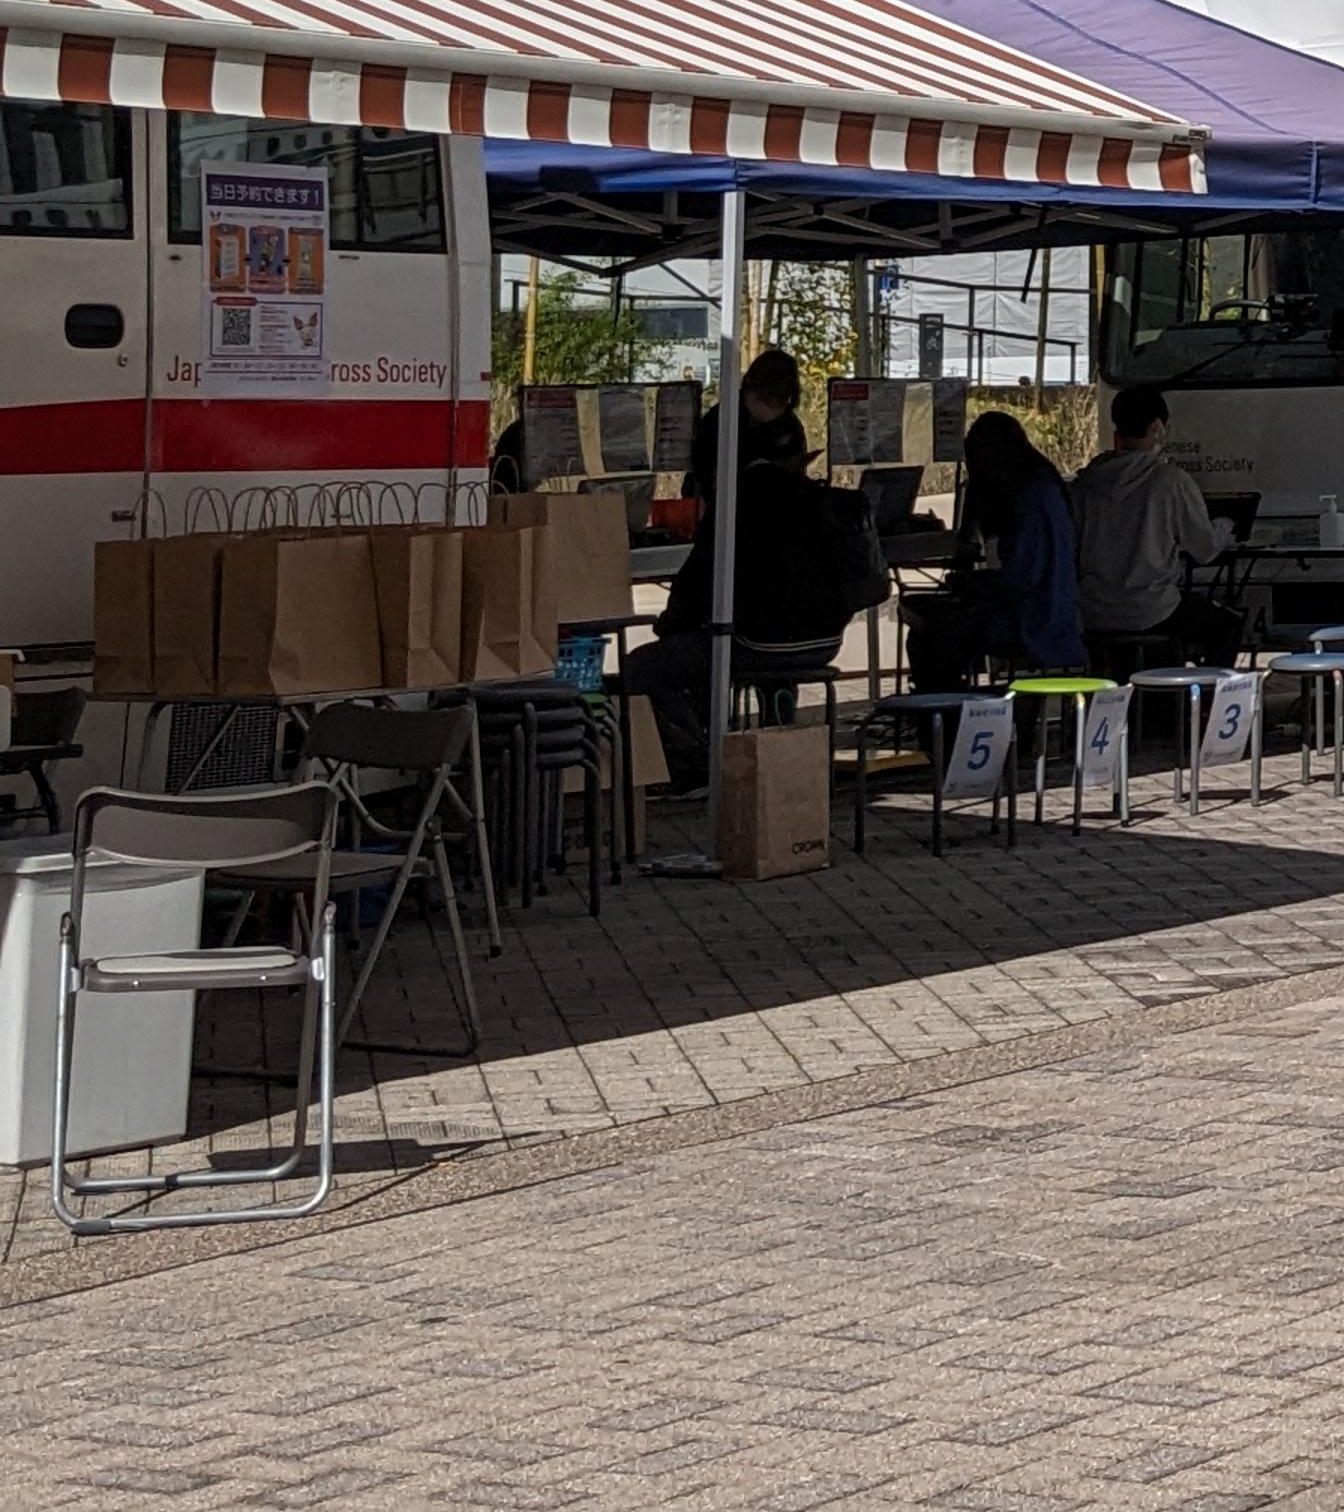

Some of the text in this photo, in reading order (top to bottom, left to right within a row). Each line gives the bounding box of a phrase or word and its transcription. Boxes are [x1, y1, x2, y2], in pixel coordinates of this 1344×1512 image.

[328, 360, 372, 383] ross
[376, 356, 447, 388] Society
[1091, 716, 1110, 755] 4
[1218, 703, 1241, 739] 3
[967, 731, 994, 770] 5
